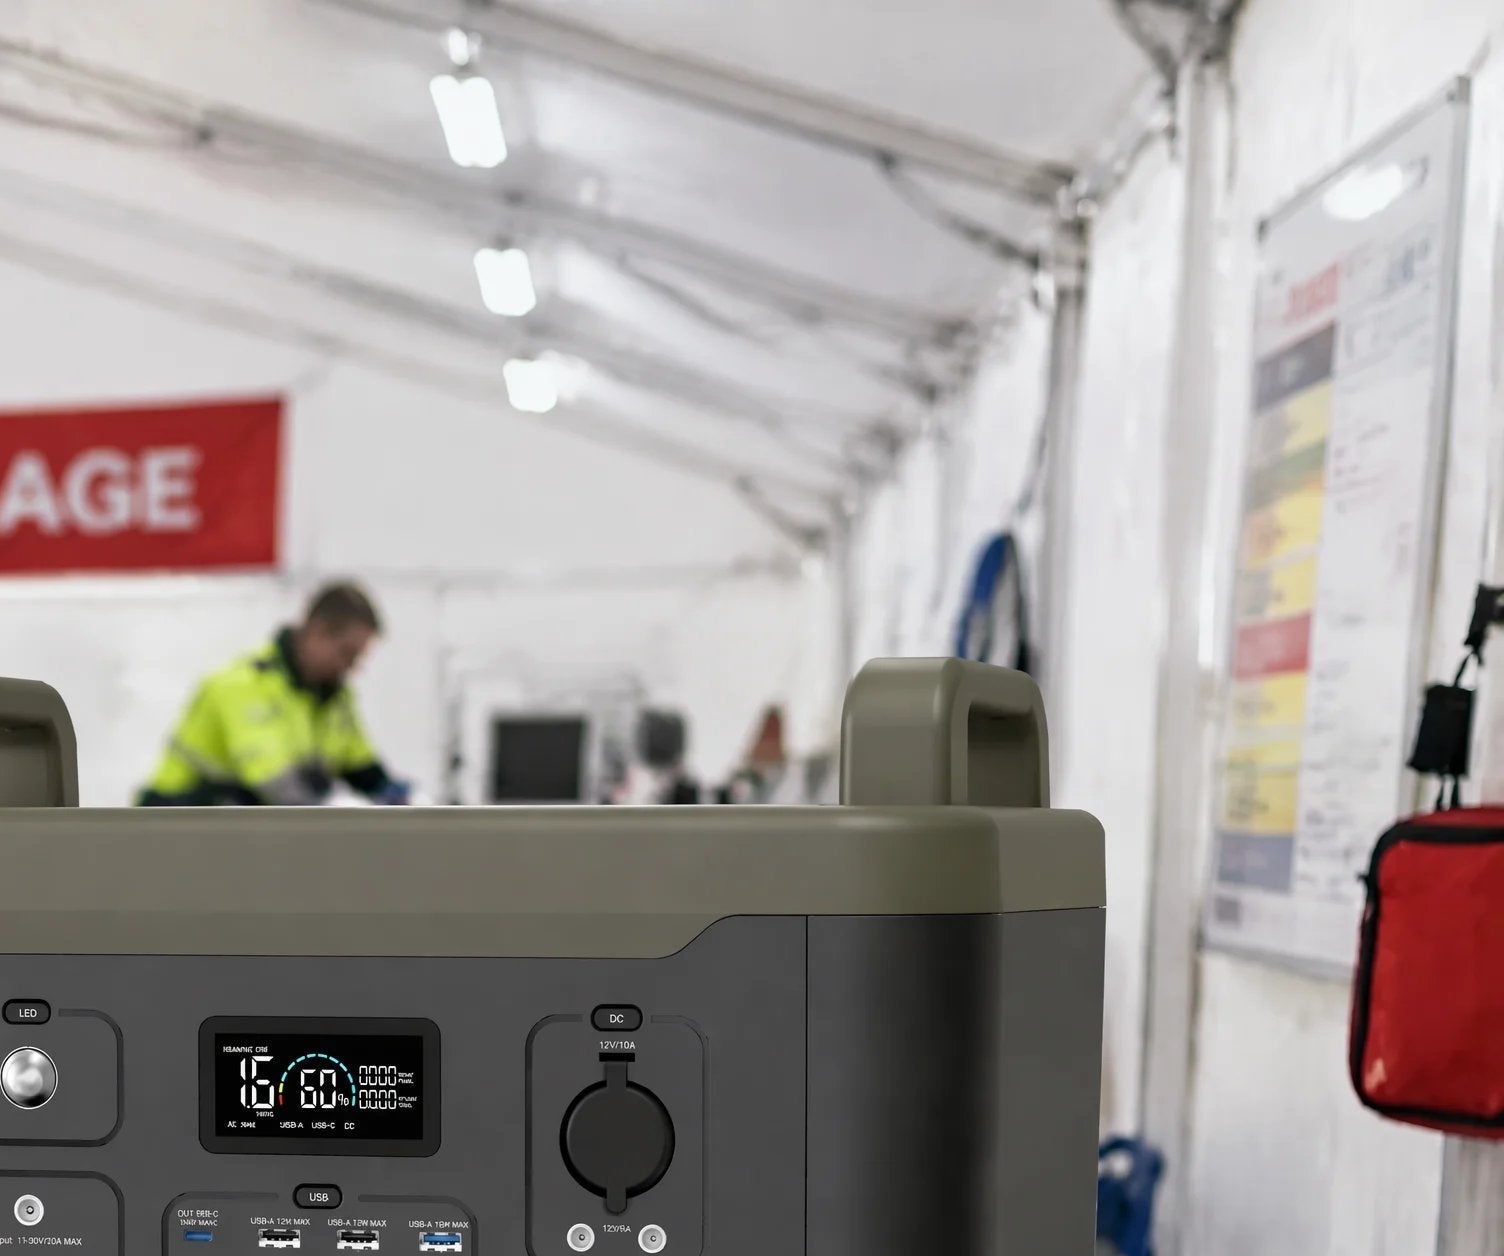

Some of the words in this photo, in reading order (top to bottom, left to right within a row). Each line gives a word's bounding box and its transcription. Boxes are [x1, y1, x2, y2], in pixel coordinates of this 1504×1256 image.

[19, 1009, 37, 1018] LED
[609, 1014, 624, 1024] DC
[600, 1040, 636, 1050] 12V/10A
[309, 1193, 329, 1202] USB
[327, 1218, 351, 1227] USB-A
[369, 1219, 387, 1228] MAX
[408, 1220, 433, 1229] USB-A
[451, 1221, 469, 1229] MAX
[63, 1237, 83, 1246] MAX
